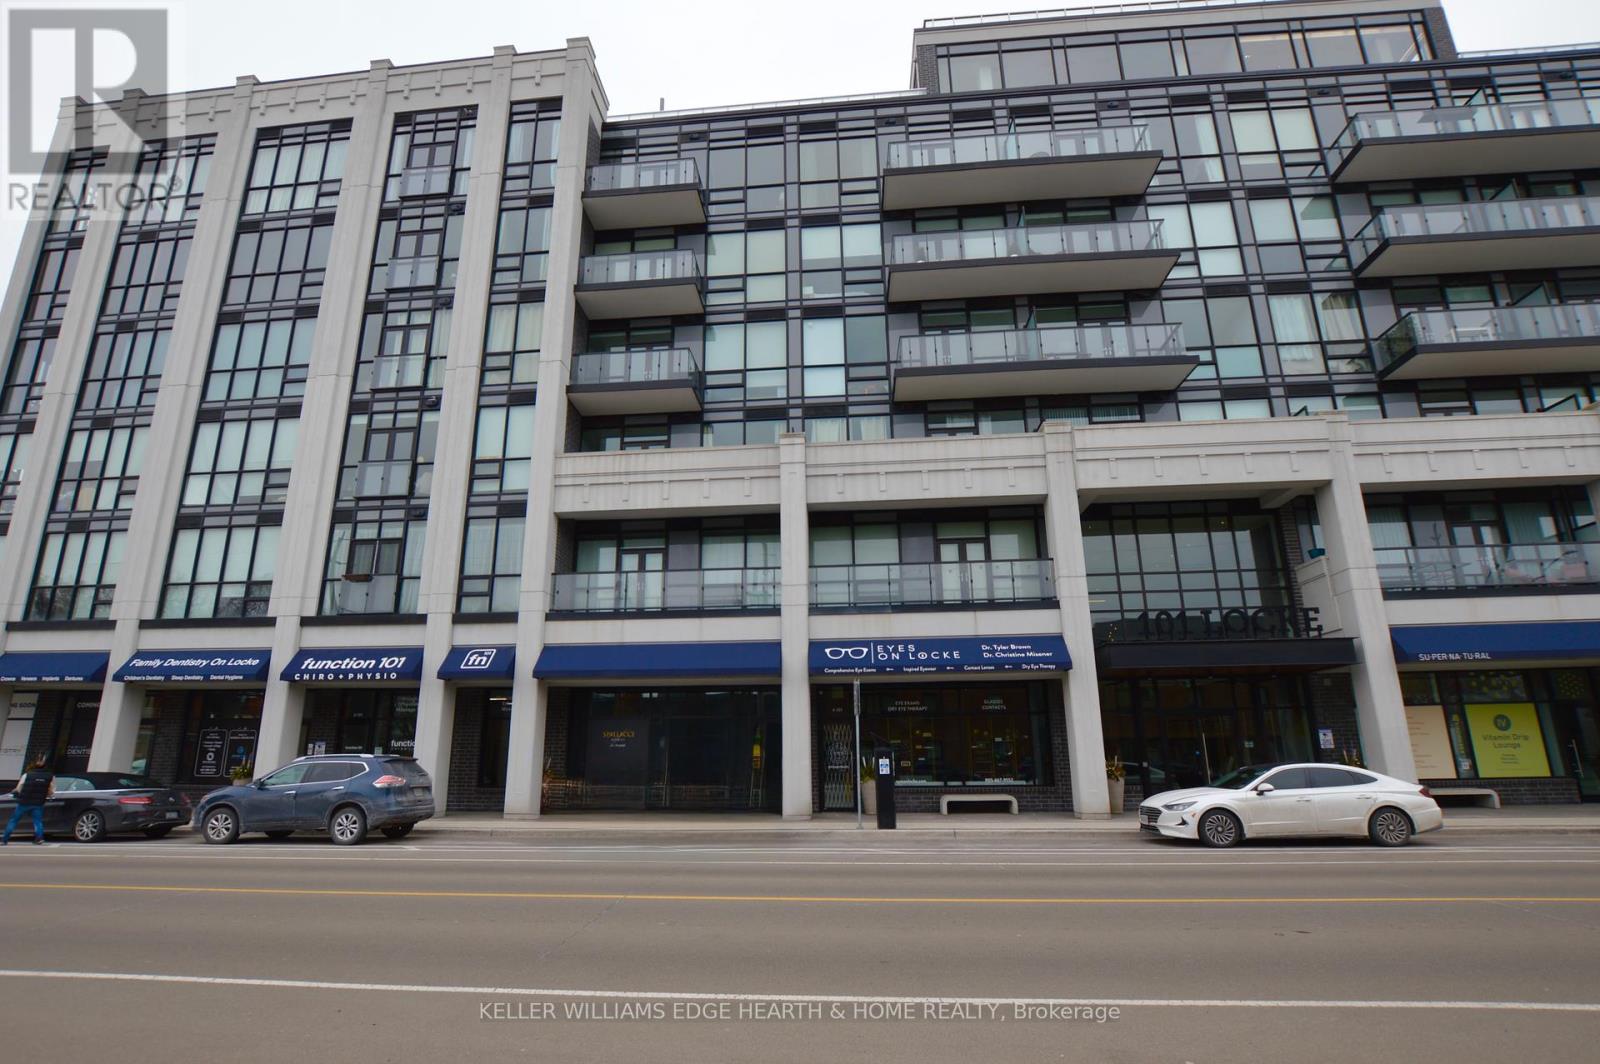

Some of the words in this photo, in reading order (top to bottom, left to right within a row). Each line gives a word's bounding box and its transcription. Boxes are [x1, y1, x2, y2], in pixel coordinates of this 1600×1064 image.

[877, 644, 915, 653] EYES
[878, 652, 900, 660] ON
[909, 651, 961, 660] LOCKE
[129, 658, 165, 668] Family
[163, 658, 210, 668] Dentistry
[210, 658, 226, 666] On
[227, 657, 260, 666] Locke
[301, 657, 376, 669] function
[378, 656, 406, 669] 101
[348, 672, 397, 680] PHYSIO
